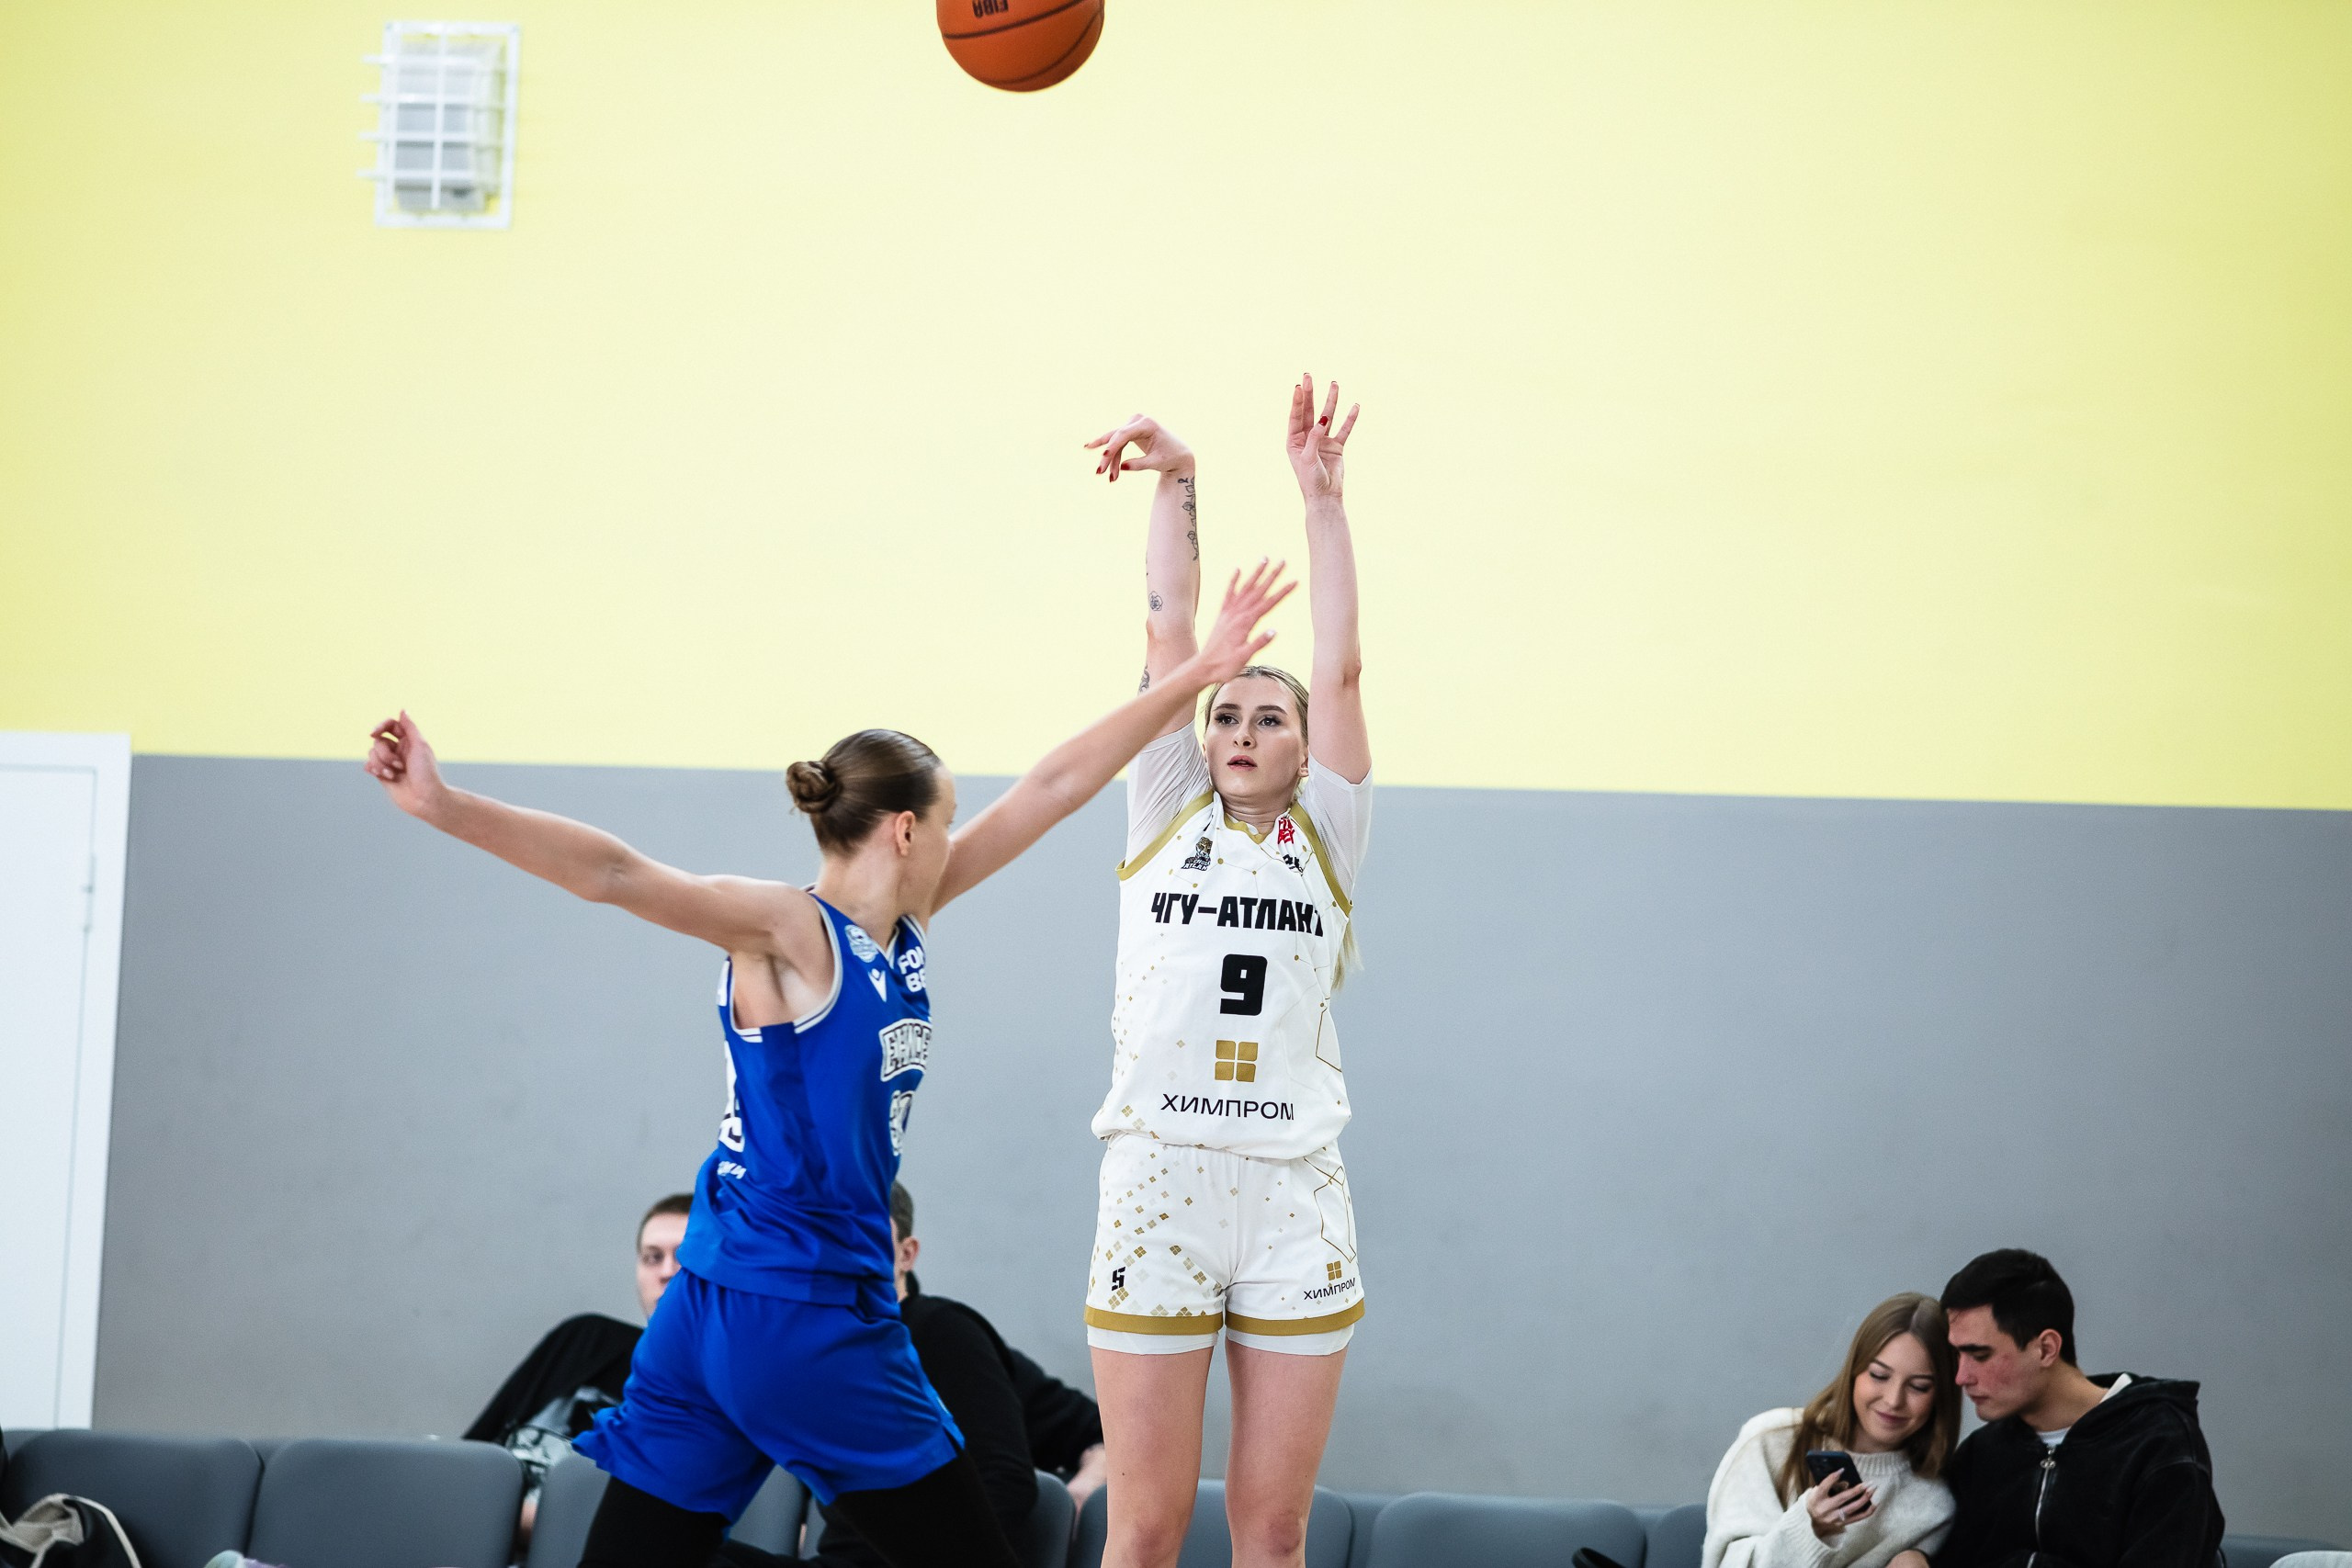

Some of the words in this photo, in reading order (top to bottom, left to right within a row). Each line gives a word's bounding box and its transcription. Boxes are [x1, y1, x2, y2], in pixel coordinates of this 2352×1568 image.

[972, 0, 1009, 17] FIBA
[1219, 953, 1268, 1017] 9
[1160, 1093, 1295, 1121] ХИМПРОМ
[1303, 1277, 1356, 1301] ХИМПРОМ
